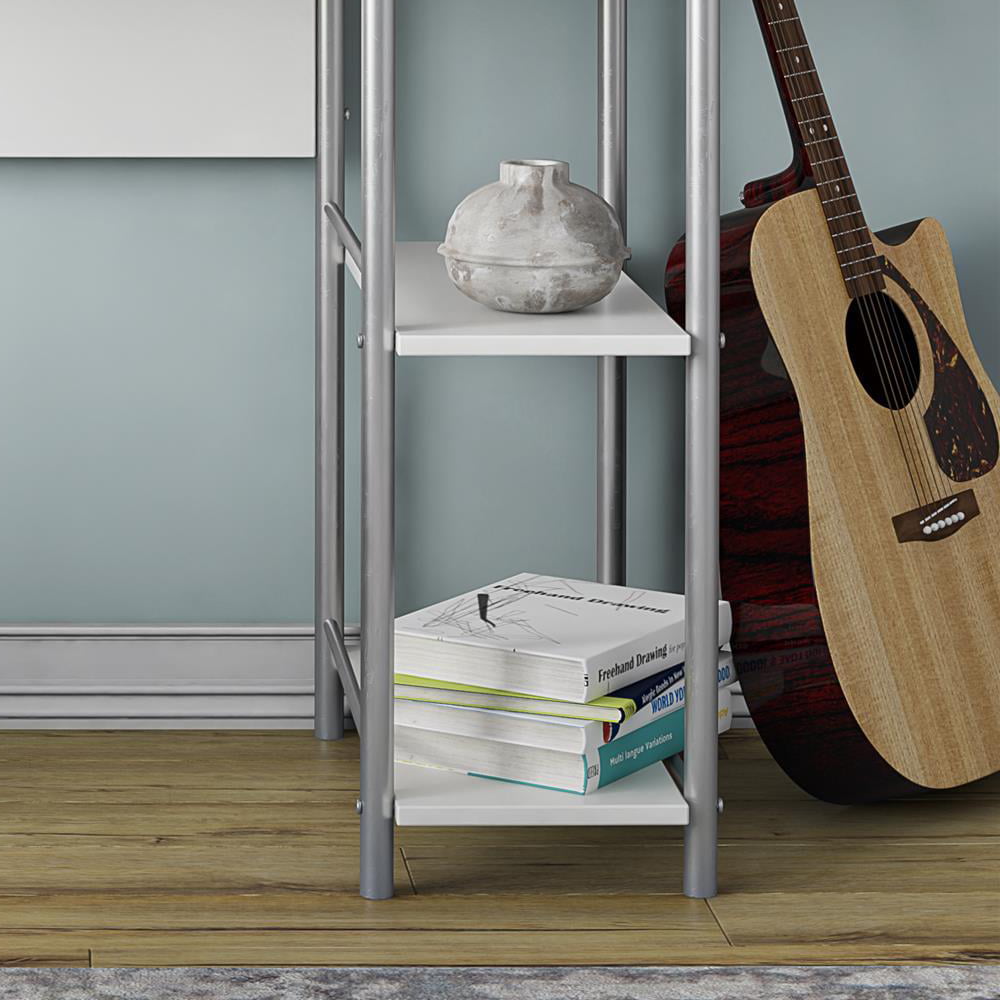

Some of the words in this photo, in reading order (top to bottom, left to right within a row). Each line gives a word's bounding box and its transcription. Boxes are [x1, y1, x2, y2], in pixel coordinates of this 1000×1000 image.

[493, 584, 585, 601] Freehand
[587, 598, 670, 614] Drawing
[598, 656, 635, 683] Freehand
[636, 644, 668, 667] Drawing
[651, 693, 674, 715] WORLD
[609, 751, 625, 766] Multi
[625, 744, 645, 760] langue
[645, 732, 673, 750] Variations
